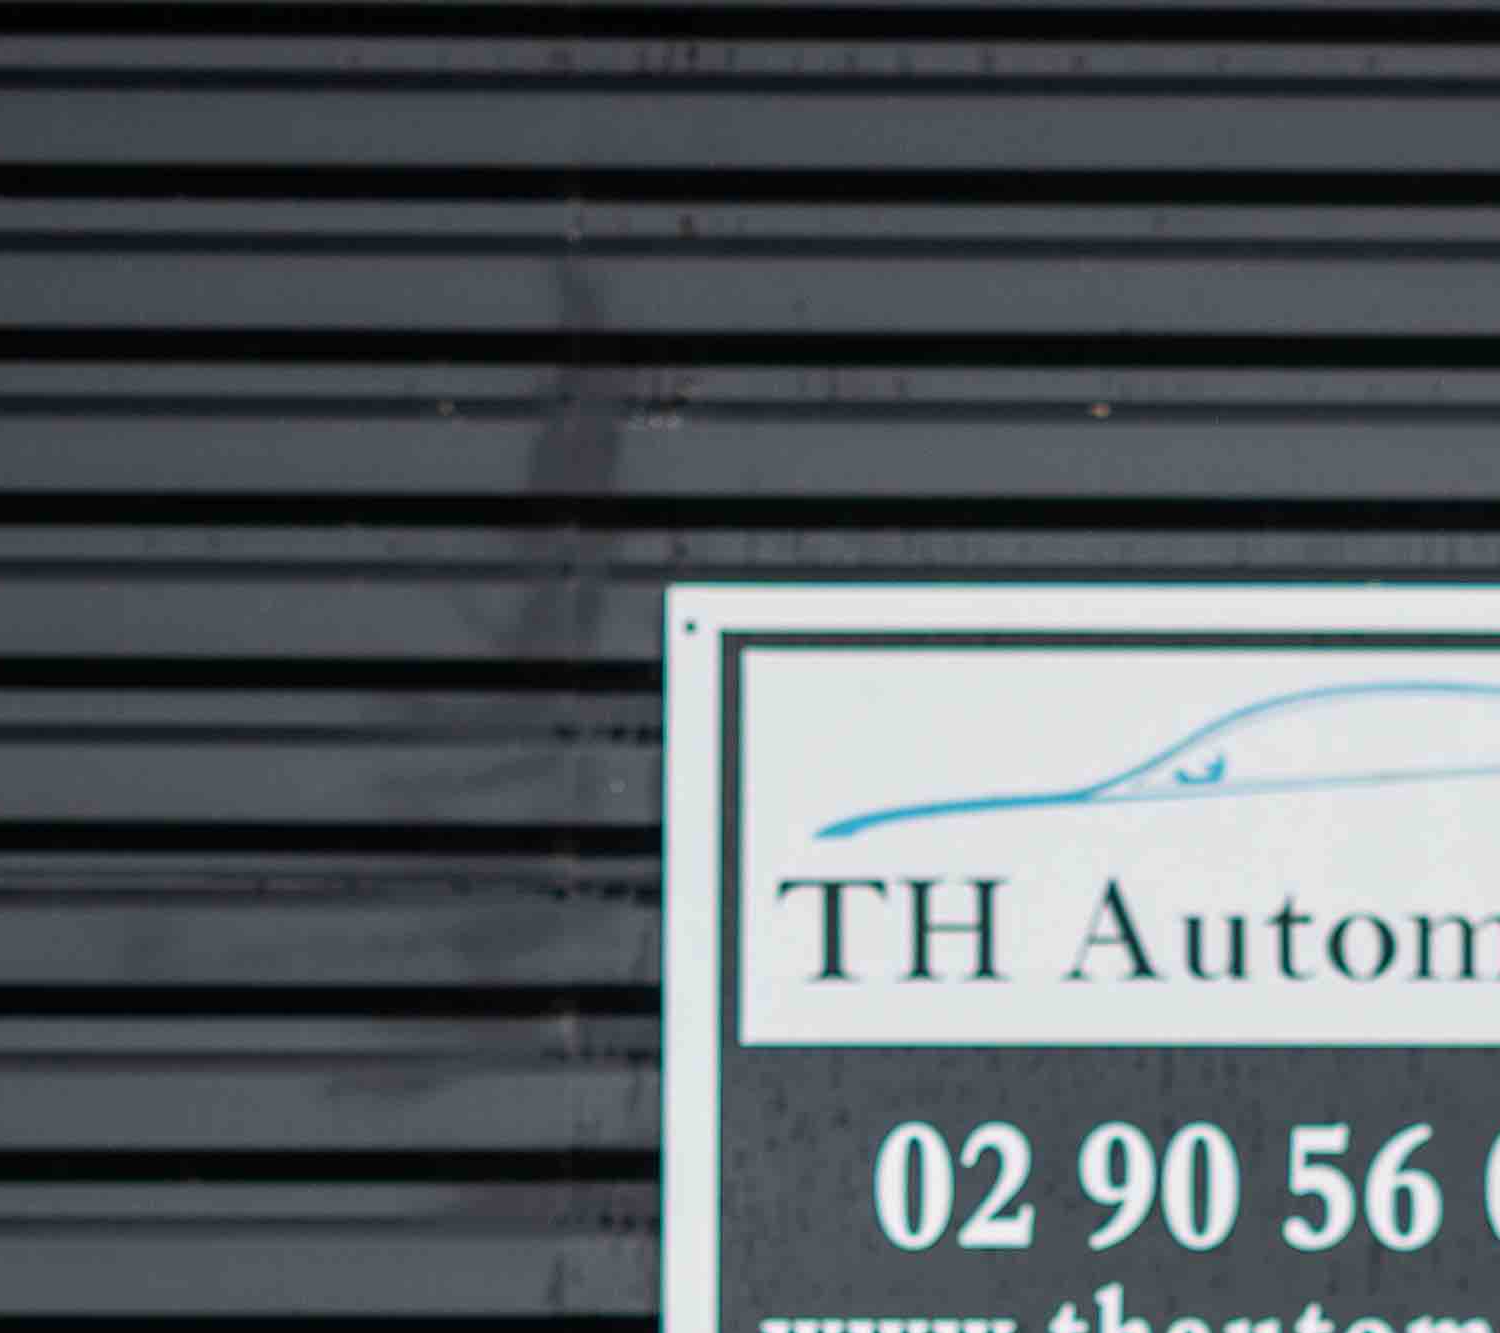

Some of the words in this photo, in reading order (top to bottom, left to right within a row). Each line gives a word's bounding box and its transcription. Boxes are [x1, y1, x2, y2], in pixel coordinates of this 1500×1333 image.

[776, 878, 1010, 984] TH
[872, 1121, 1036, 1252] 02
[1076, 1121, 1240, 1252] 90
[1281, 1121, 1443, 1252] 56
